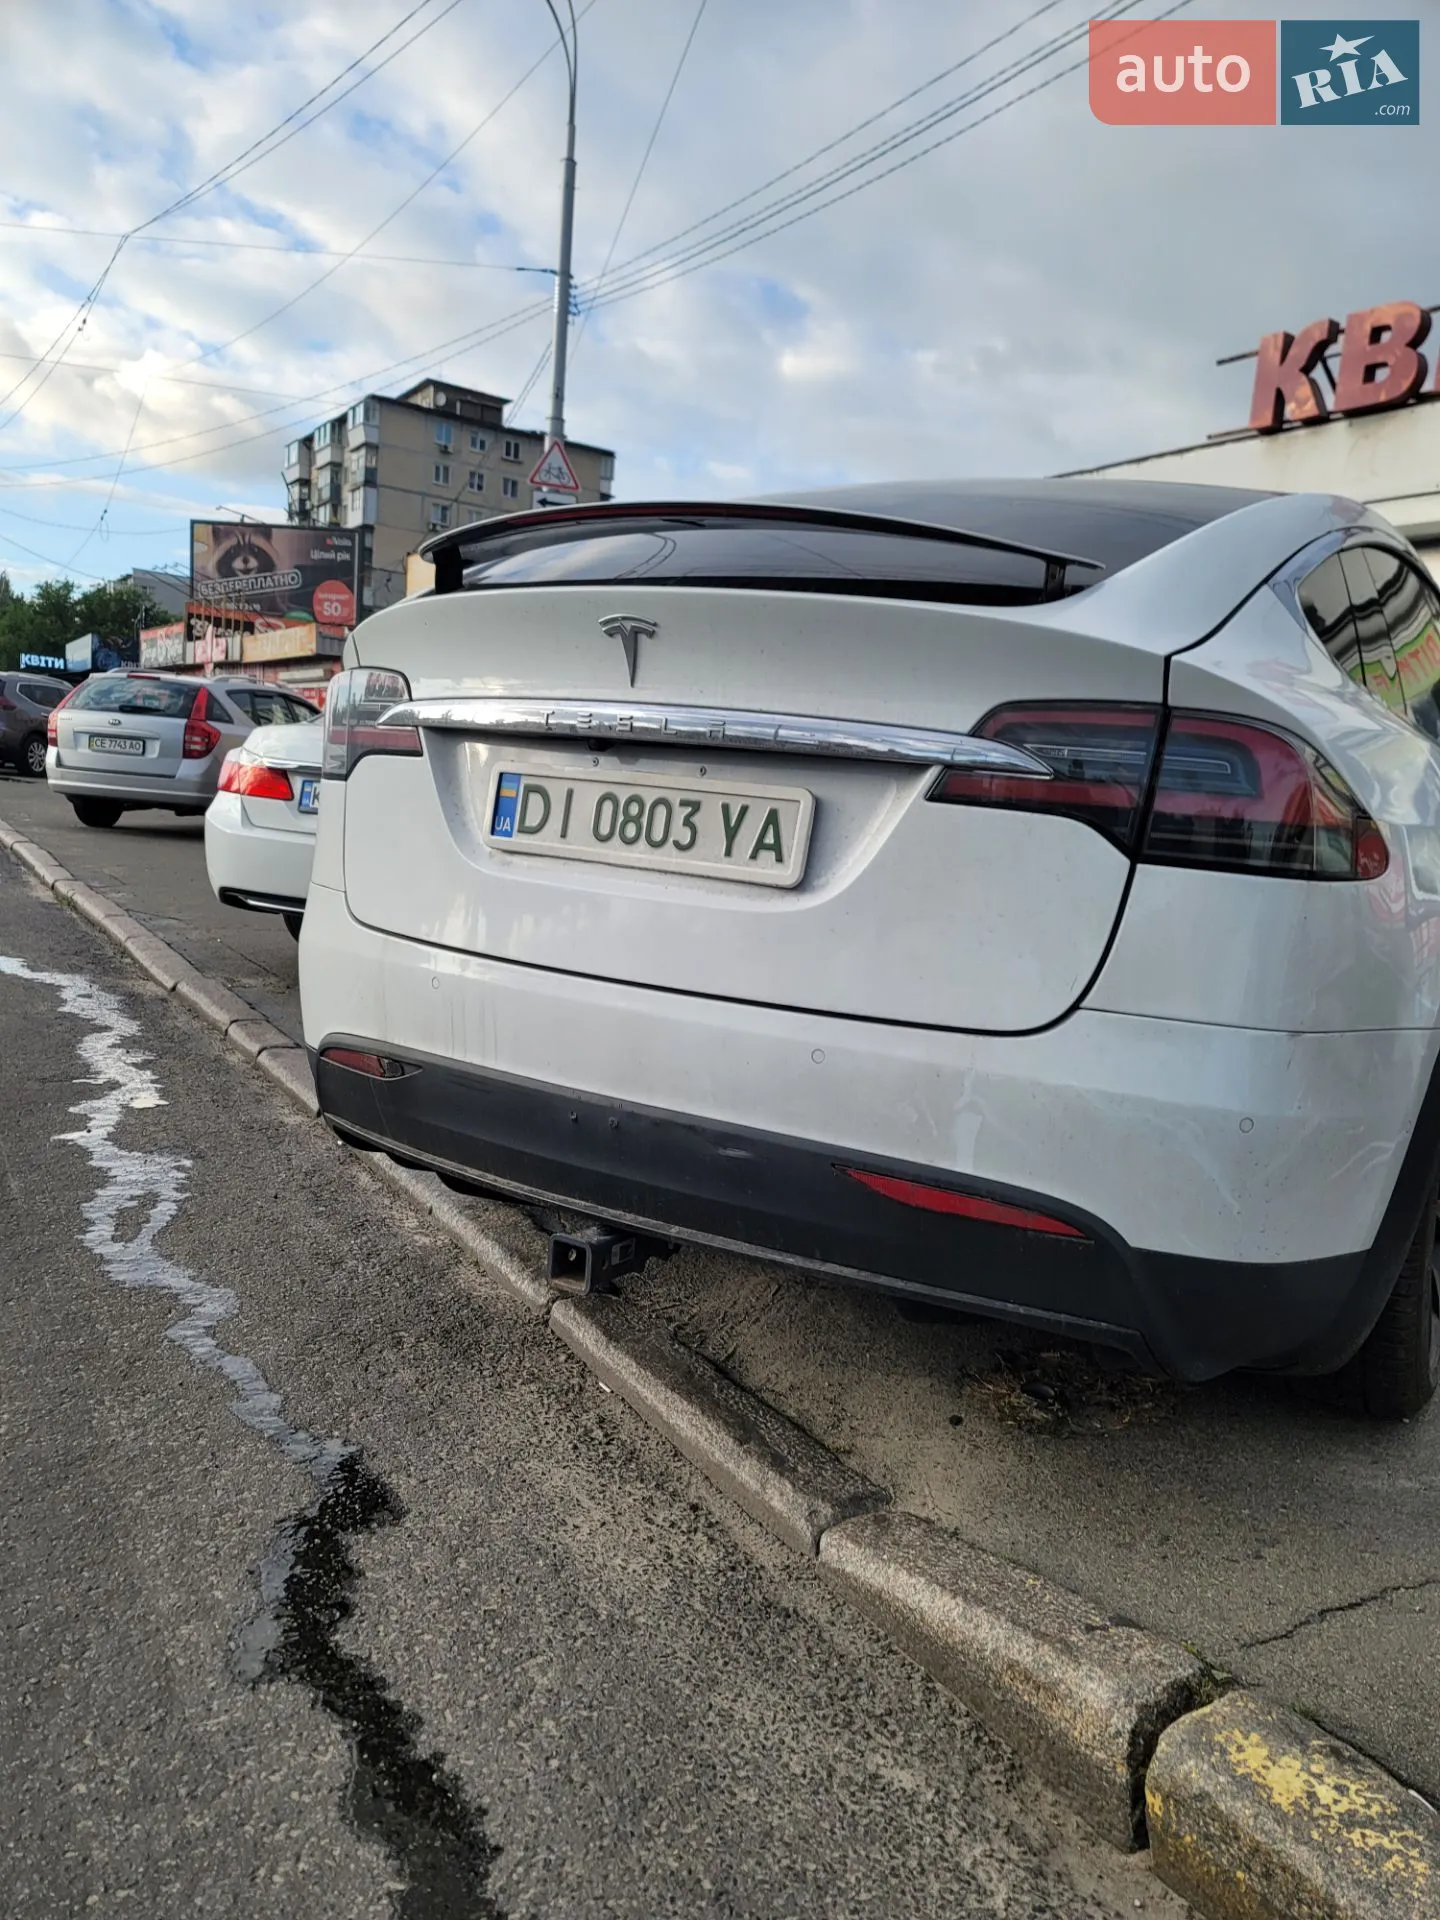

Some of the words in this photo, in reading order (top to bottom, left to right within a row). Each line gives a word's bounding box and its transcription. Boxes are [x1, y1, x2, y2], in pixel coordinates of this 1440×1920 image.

[1248, 299, 1440, 434] КВ
[323, 601, 342, 617] 50
[21, 652, 65, 669] КВІТИ
[543, 710, 727, 739] TESLA
[95, 738, 107, 748] CE
[108, 740, 127, 750] 7743
[494, 815, 511, 832] UA
[517, 783, 574, 838] DI
[592, 791, 701, 852] 0803
[721, 802, 783, 863] YA
